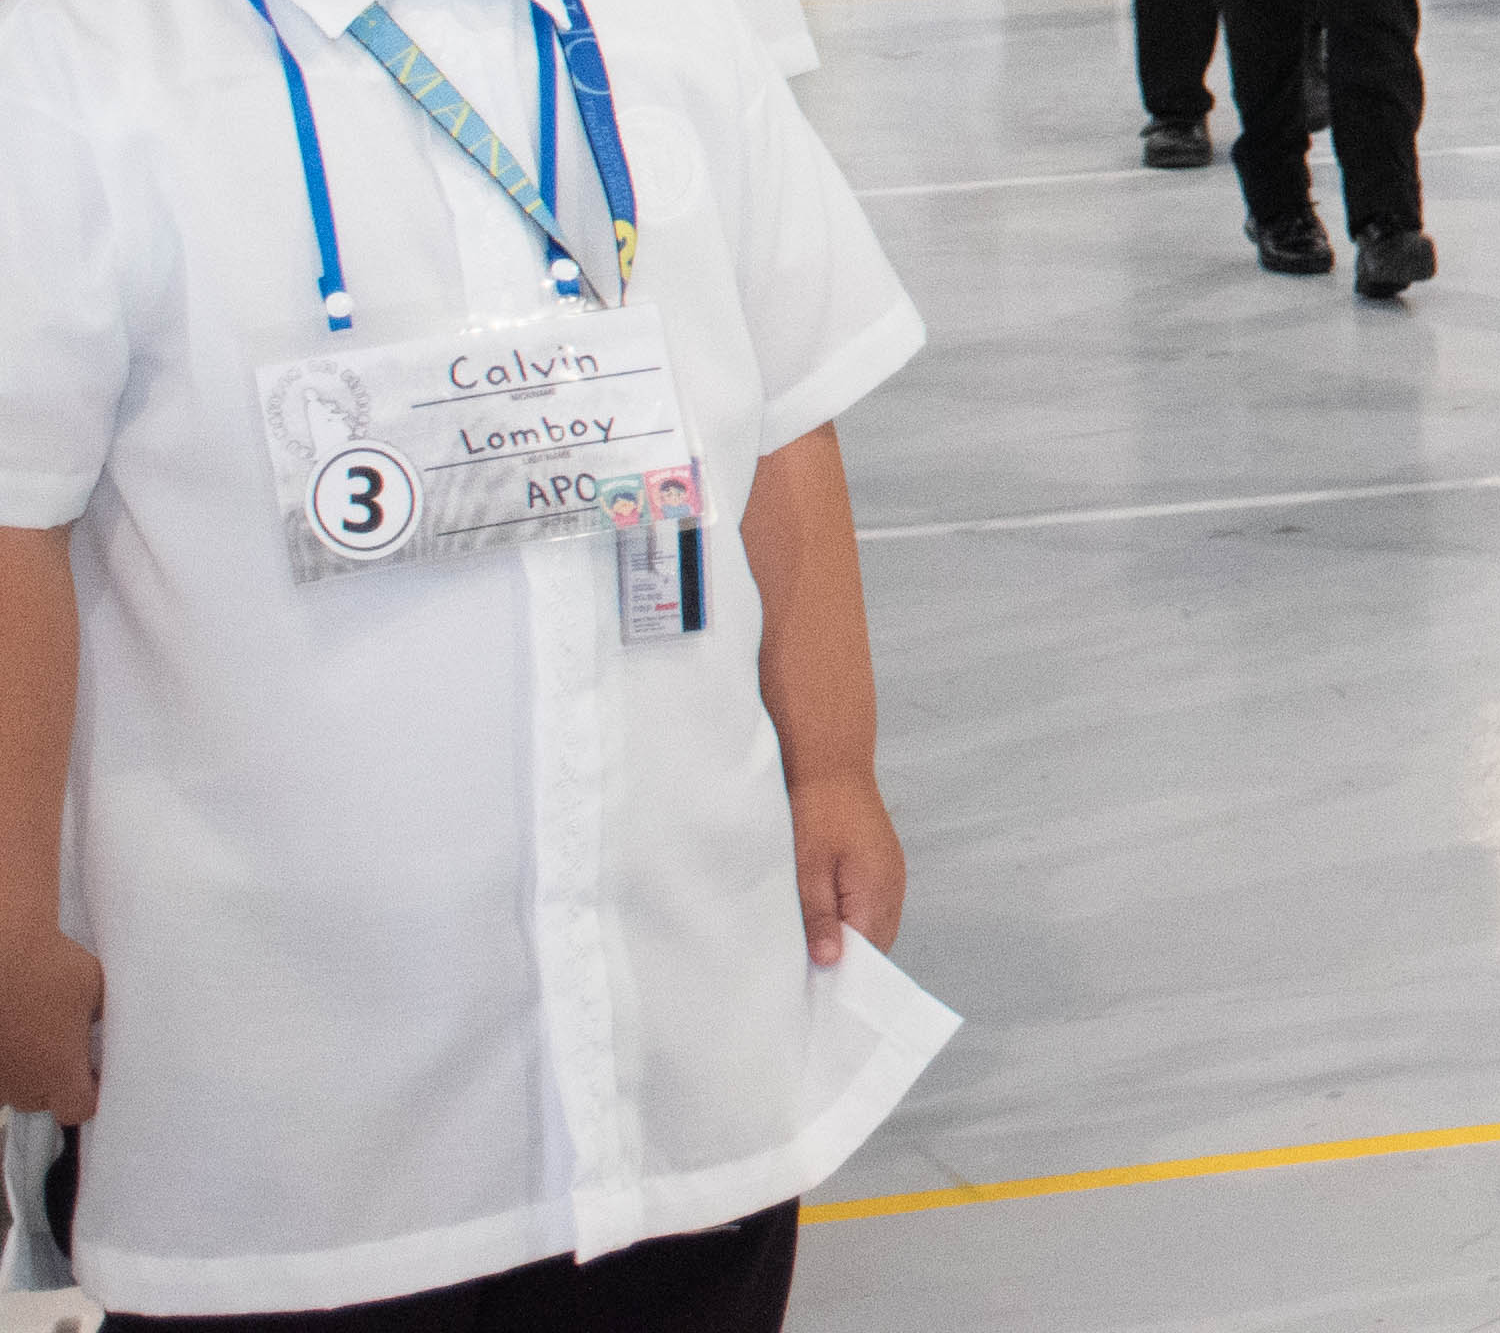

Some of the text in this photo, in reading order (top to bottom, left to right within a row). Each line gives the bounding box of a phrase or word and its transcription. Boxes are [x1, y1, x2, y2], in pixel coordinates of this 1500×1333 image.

[449, 346, 600, 390] Calvin
[459, 416, 615, 455] Lomboy
[341, 465, 386, 534] 3
[527, 472, 597, 509] APO
